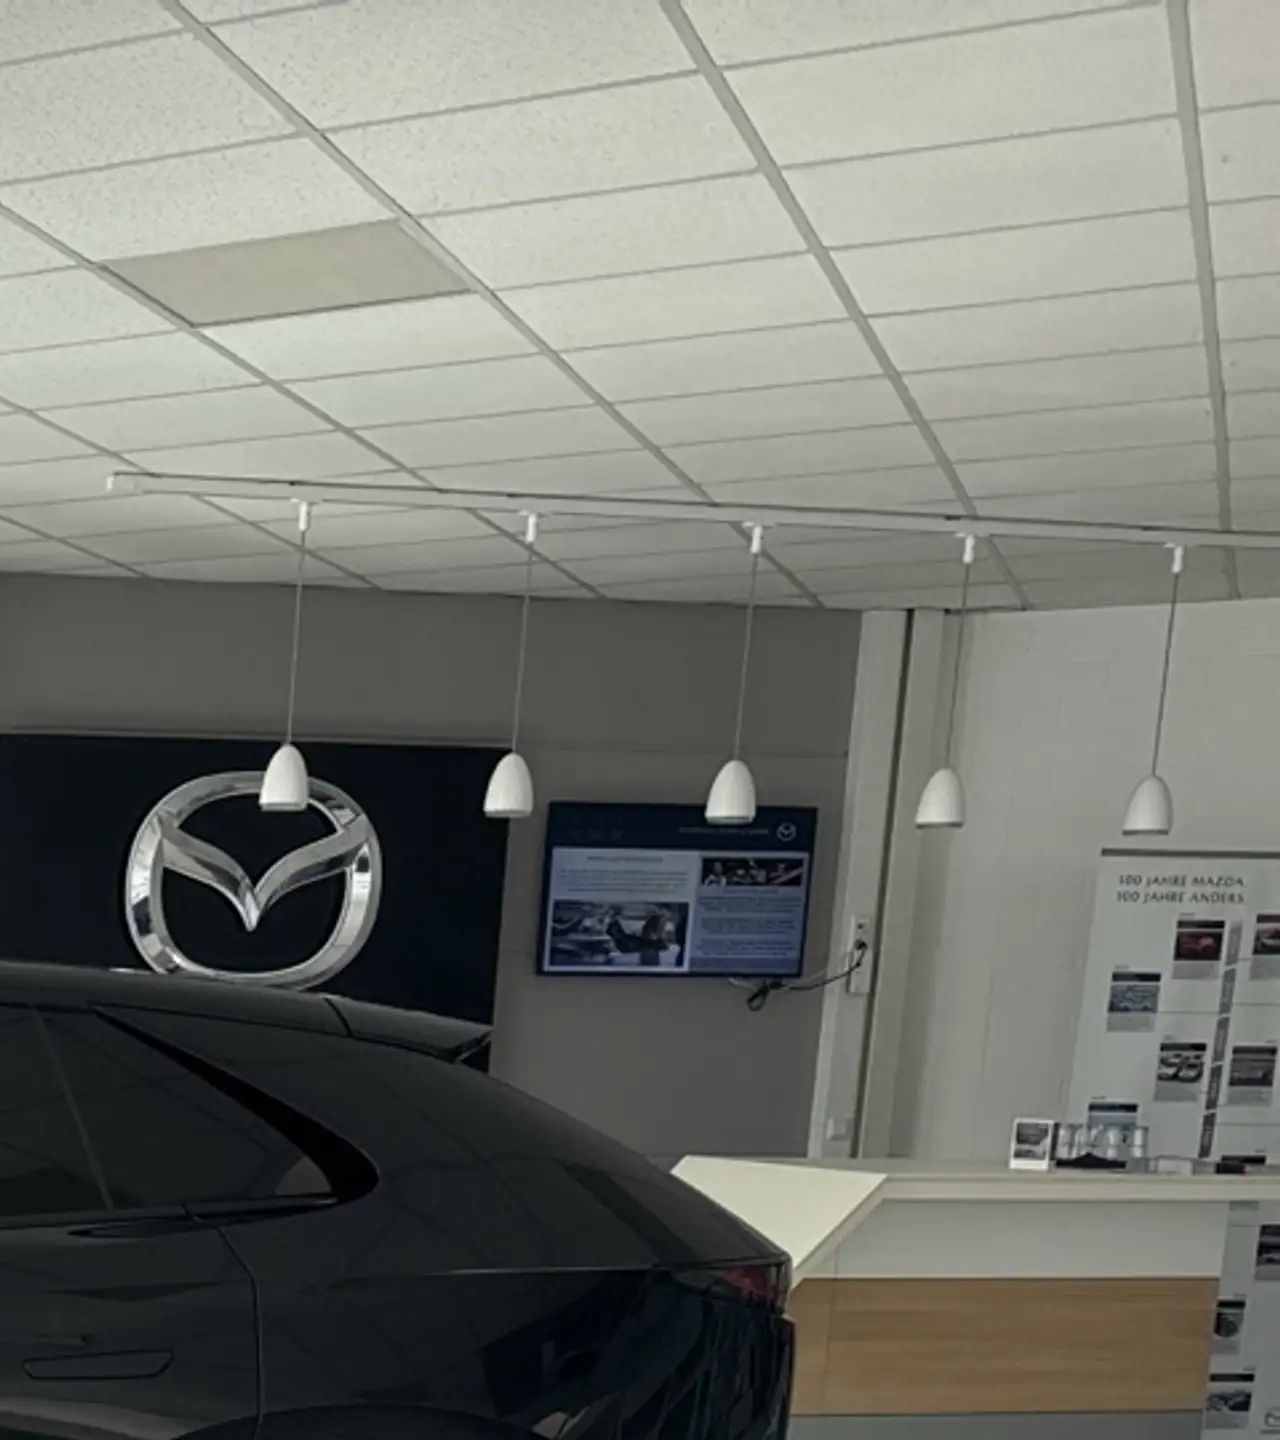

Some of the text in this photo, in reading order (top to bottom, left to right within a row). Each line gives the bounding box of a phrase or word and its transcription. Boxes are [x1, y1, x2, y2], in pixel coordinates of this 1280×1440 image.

[1118, 874, 1245, 888] 100 JAHRE MAZDA
[1116, 890, 1245, 904] 100 JAHRE ANDERS
